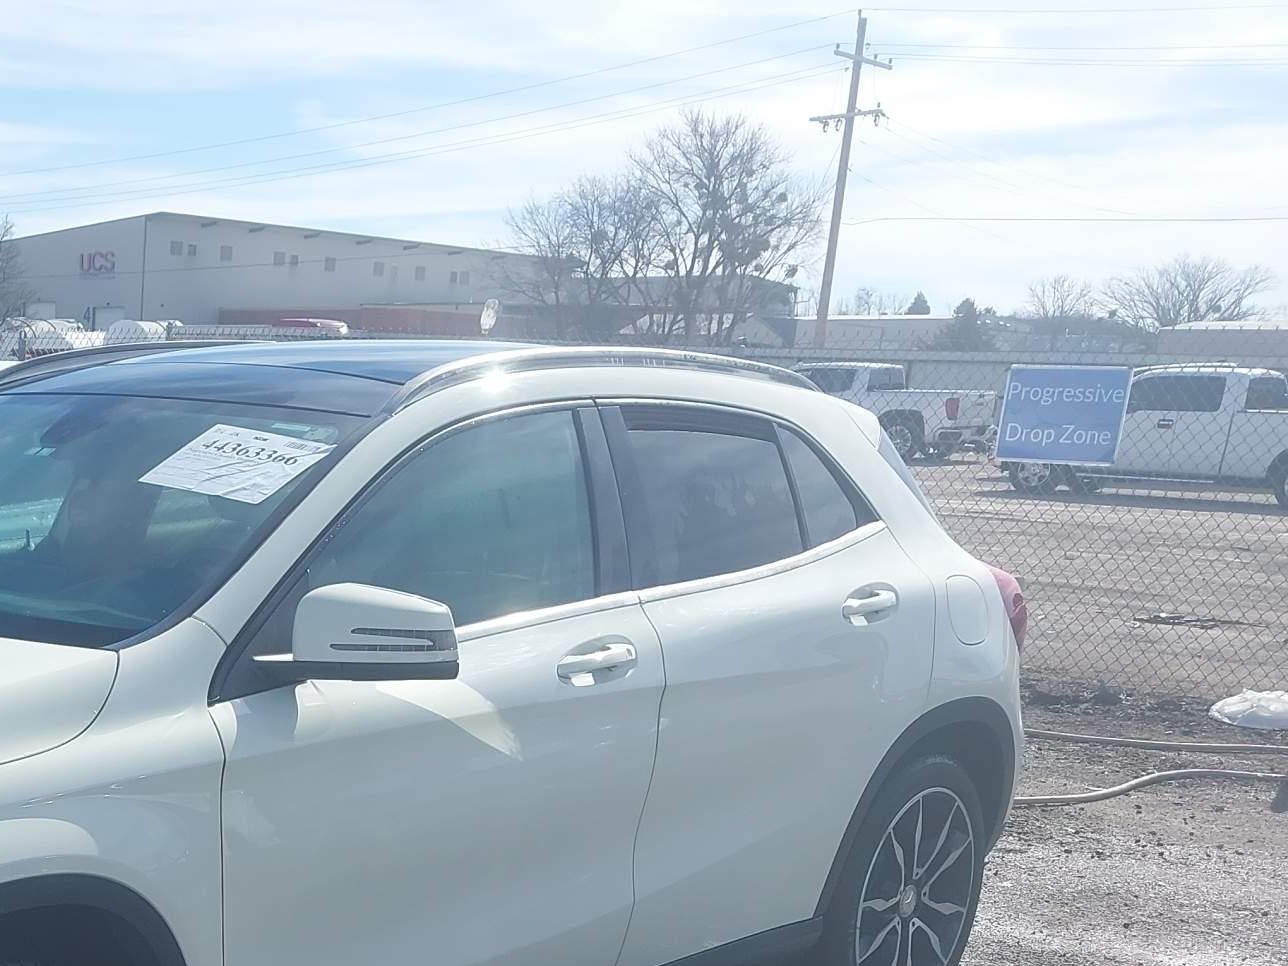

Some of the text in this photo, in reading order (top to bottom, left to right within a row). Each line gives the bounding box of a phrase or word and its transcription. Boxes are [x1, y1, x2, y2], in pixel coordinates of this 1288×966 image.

[80, 251, 115, 272] UCS
[1008, 382, 1125, 406] Progressive
[1005, 423, 1112, 447] Drop Zone
[201, 439, 299, 466] 44363366
